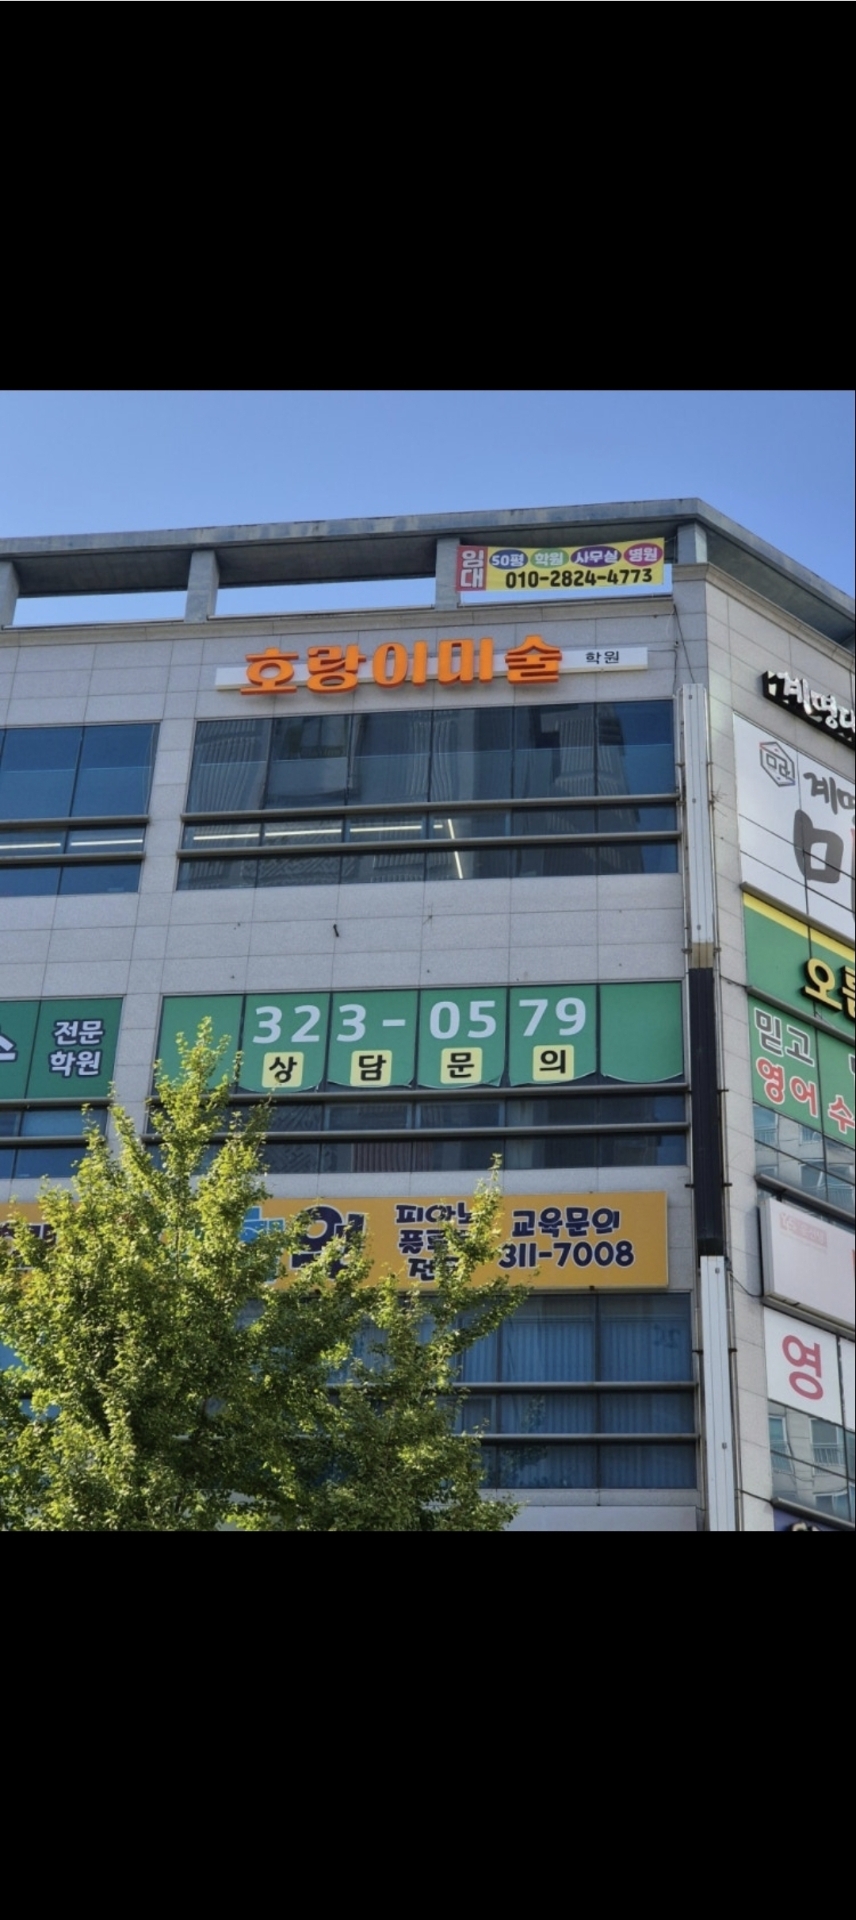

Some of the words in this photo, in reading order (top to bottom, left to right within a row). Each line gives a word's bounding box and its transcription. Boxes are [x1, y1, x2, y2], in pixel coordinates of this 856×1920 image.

[460, 549, 485, 588] 임대
[491, 553, 524, 567] 50평
[534, 551, 565, 567] 학원
[575, 549, 619, 565] 사무실
[505, 568, 653, 588] 010-2824-4773
[240, 634, 564, 695] 호랑이미술
[585, 650, 620, 665] 학원
[54, 1020, 104, 1046] 전문
[754, 1007, 815, 1067] 믿고
[49, 1050, 102, 1077] 학원
[755, 1057, 819, 1118] 영어
[511, 1206, 620, 1238] 교육문의
[498, 1240, 636, 1269] 311-7008
[781, 1333, 825, 1402] 영
